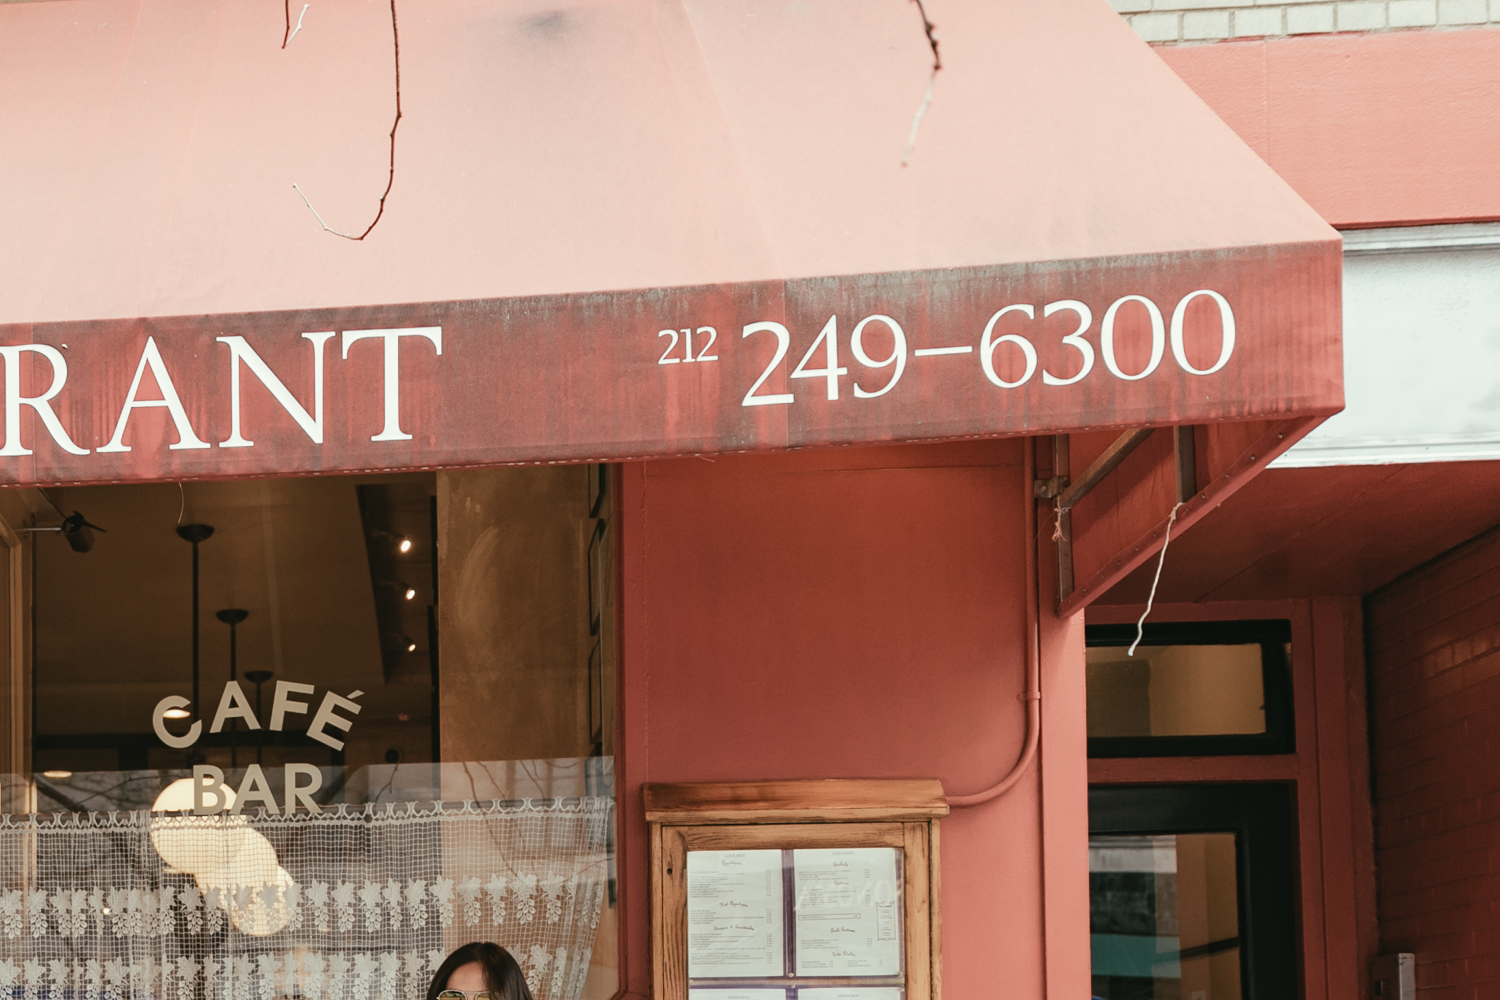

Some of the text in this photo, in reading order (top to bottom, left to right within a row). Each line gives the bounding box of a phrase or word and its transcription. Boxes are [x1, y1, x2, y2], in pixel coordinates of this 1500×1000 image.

[657, 325, 720, 365] 212
[152, 680, 366, 752] CAFÉ
[192, 762, 324, 816] BAR
